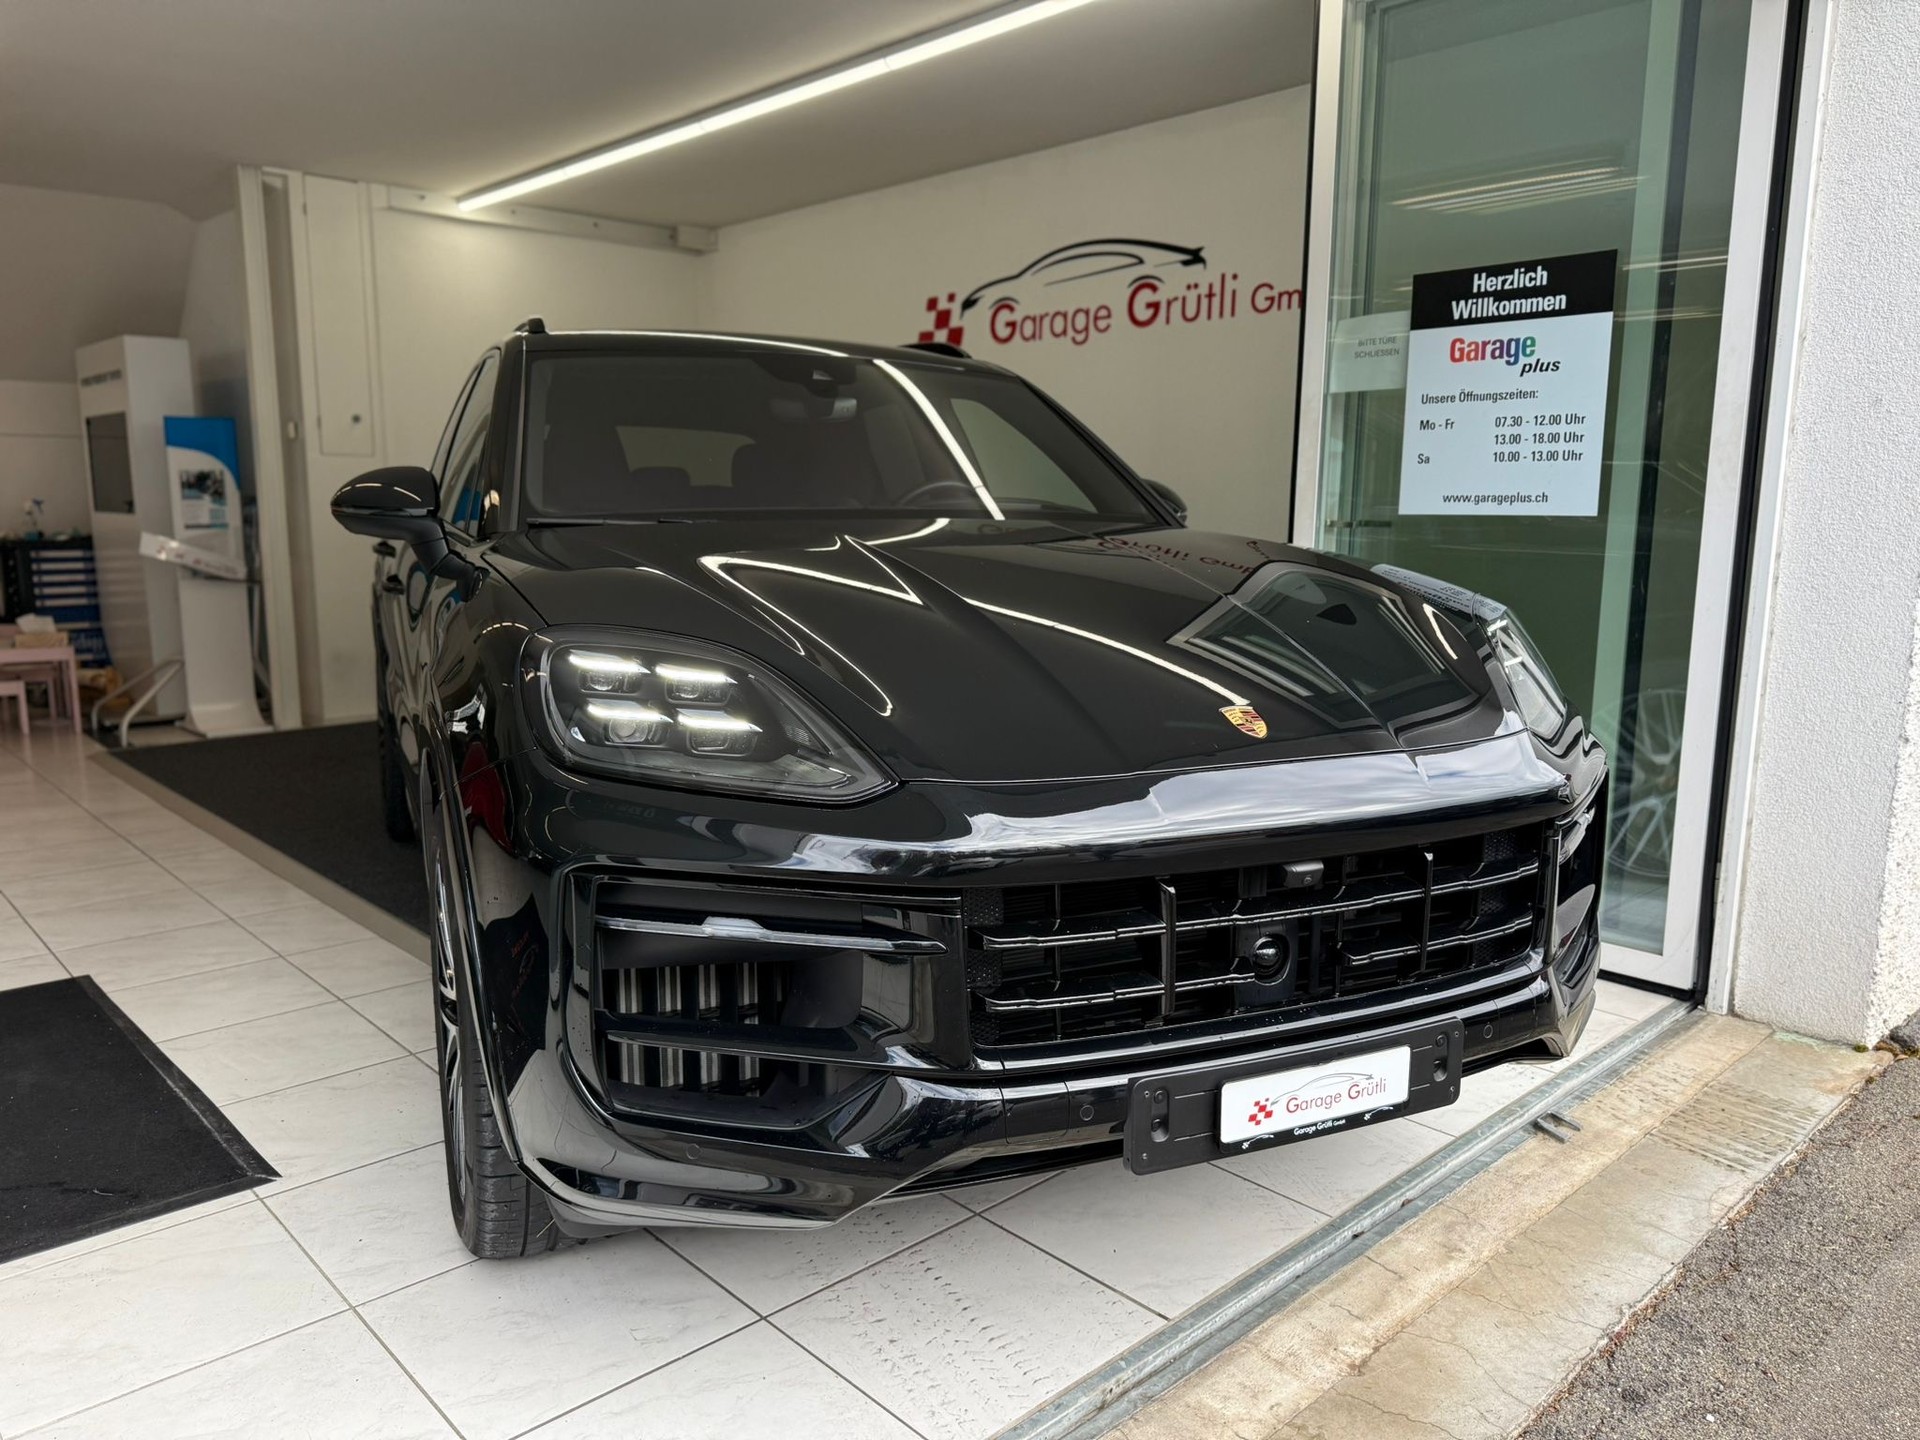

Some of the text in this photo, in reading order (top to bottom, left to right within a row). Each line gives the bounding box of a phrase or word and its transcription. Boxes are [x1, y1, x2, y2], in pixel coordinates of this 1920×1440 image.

[1472, 265, 1548, 293] Herzlich
[989, 302, 1112, 346] Garage
[1127, 273, 1239, 328] Grütli
[1451, 294, 1567, 320] Willkommen
[1354, 348, 1400, 359] SCHLIESSEN
[1449, 335, 1536, 366] Garage
[1519, 358, 1561, 377] plus
[1421, 388, 1539, 405] Unsere Öffnungszeiten:
[1419, 420, 1436, 431] Mo
[1445, 419, 1455, 430] Fr
[1494, 415, 1523, 428] 07.30
[1533, 414, 1562, 427] 12.00
[1564, 413, 1586, 425] Uhr
[1494, 434, 1521, 446] 13.00
[1532, 433, 1560, 444] 18.00
[1563, 432, 1585, 443] Uhr
[1417, 454, 1430, 465] Sa
[1493, 452, 1520, 463] 10.00
[1531, 451, 1559, 462] 13.00
[1562, 450, 1583, 462] Uhr
[1442, 492, 1549, 506] www.garageplus.ch
[1285, 1078, 1387, 1114] Garage Grütli
[1293, 1125, 1316, 1136] Garage
